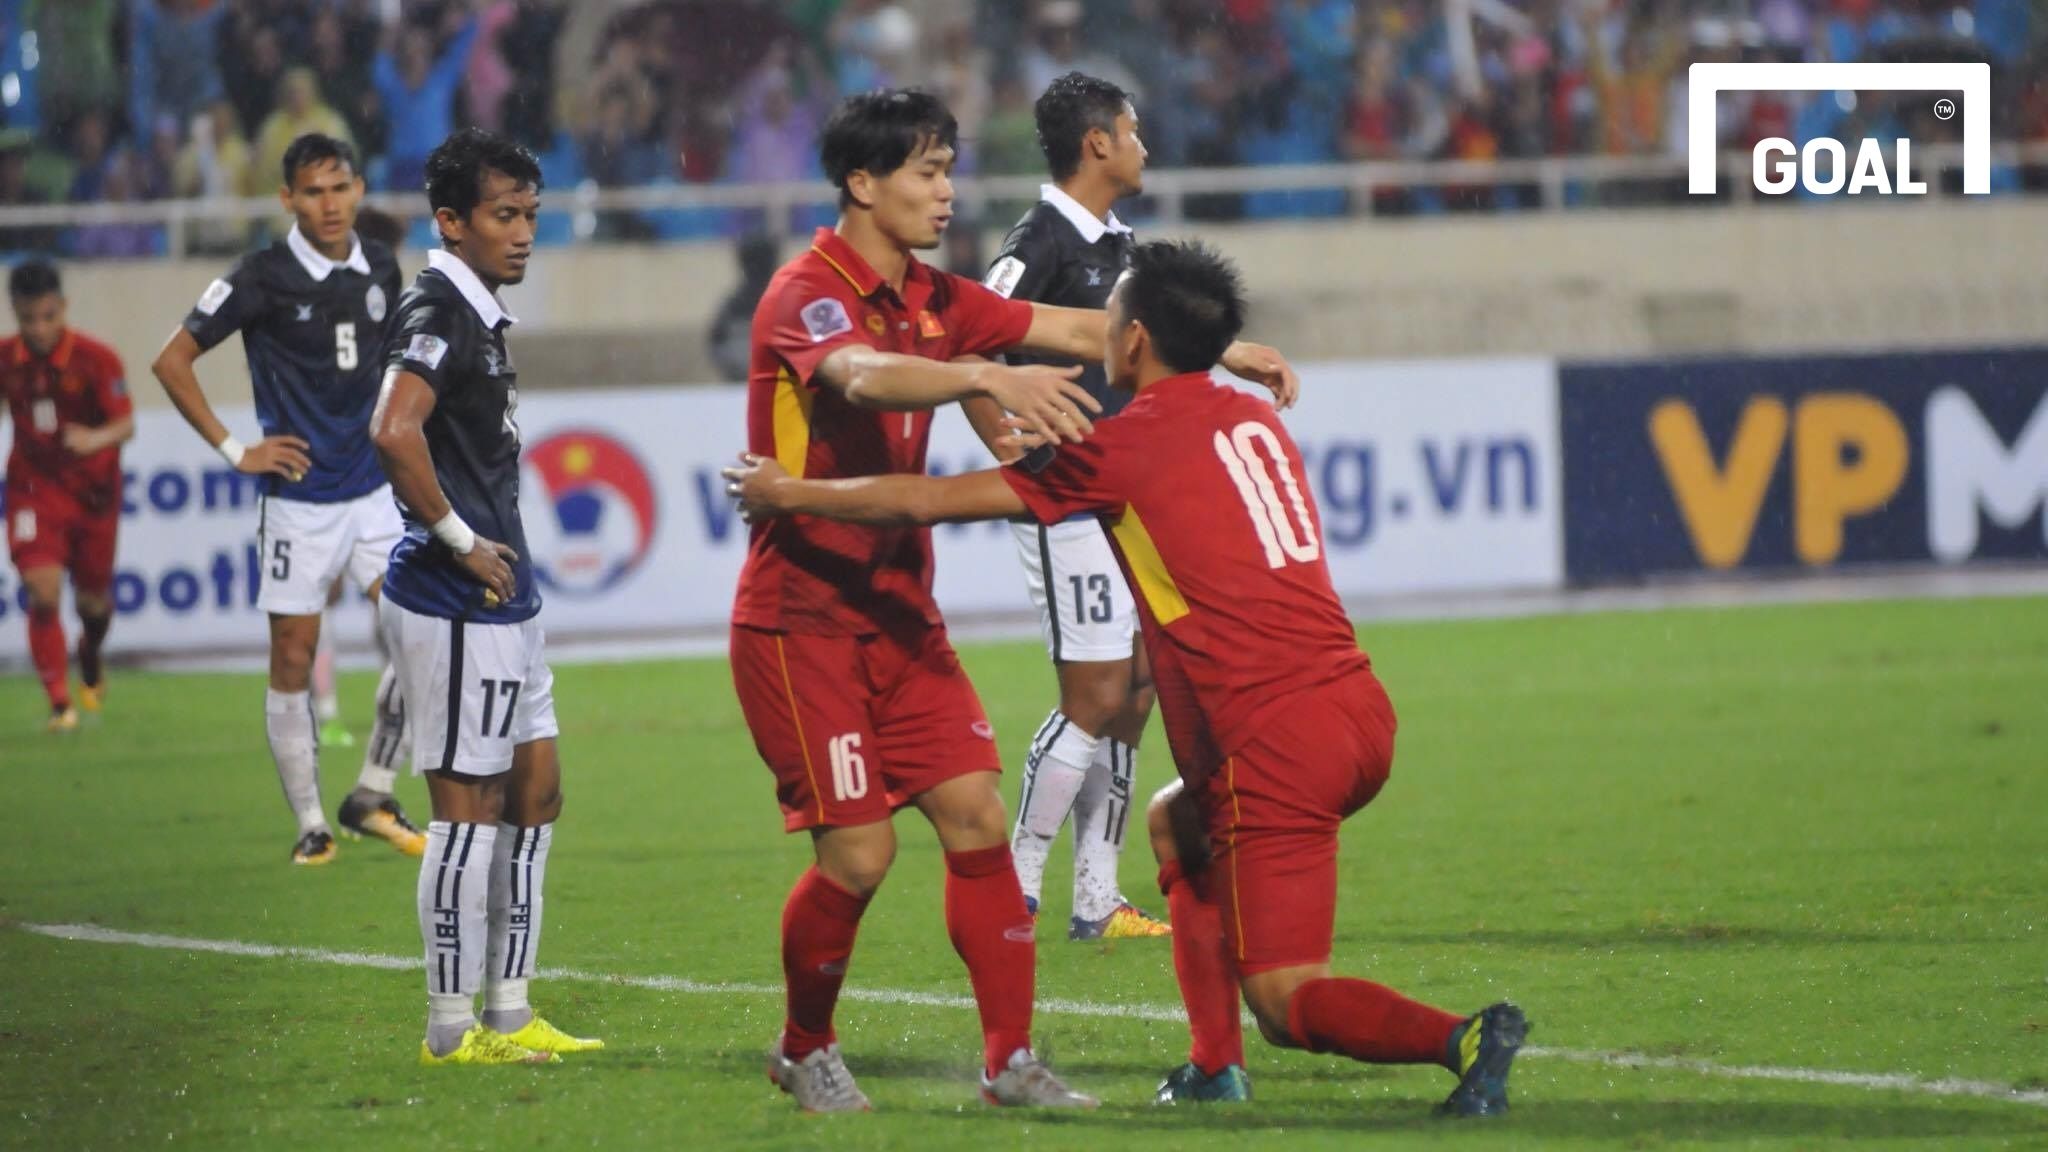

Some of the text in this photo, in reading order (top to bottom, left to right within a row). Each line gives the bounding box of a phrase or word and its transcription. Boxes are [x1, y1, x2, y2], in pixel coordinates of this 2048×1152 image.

[335, 322, 358, 371] 5
[1213, 420, 1320, 570] 10
[1299, 436, 1539, 549] g.vn
[1648, 388, 2048, 569] VPM
[271, 540, 292, 581] 5
[1068, 573, 1112, 626] 13
[480, 677, 521, 739] 17
[827, 732, 868, 802] 16
[433, 907, 461, 954] FBT
